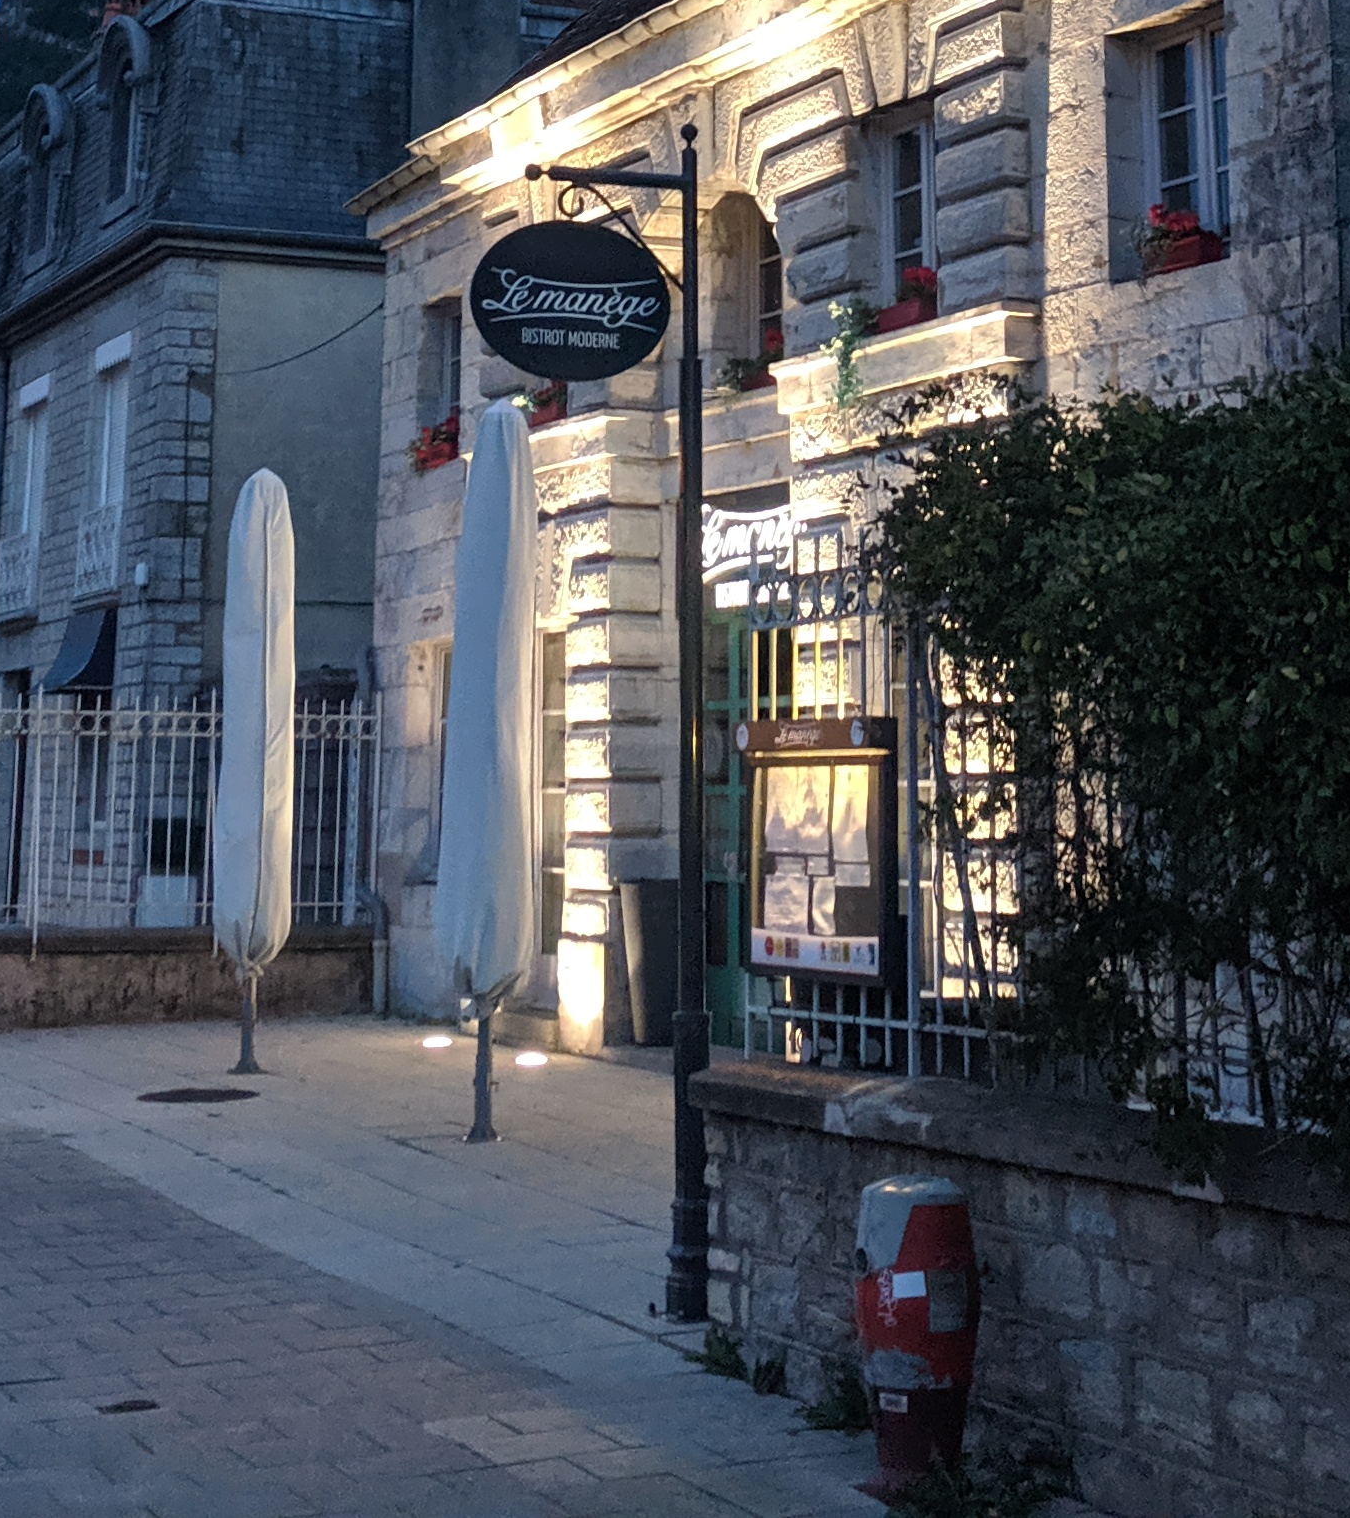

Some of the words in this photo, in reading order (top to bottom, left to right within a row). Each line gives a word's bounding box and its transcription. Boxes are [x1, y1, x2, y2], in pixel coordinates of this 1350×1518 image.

[482, 268, 534, 313] Le
[532, 285, 661, 328] manège
[521, 327, 565, 345] BISTROT
[567, 330, 621, 350] MODERNE
